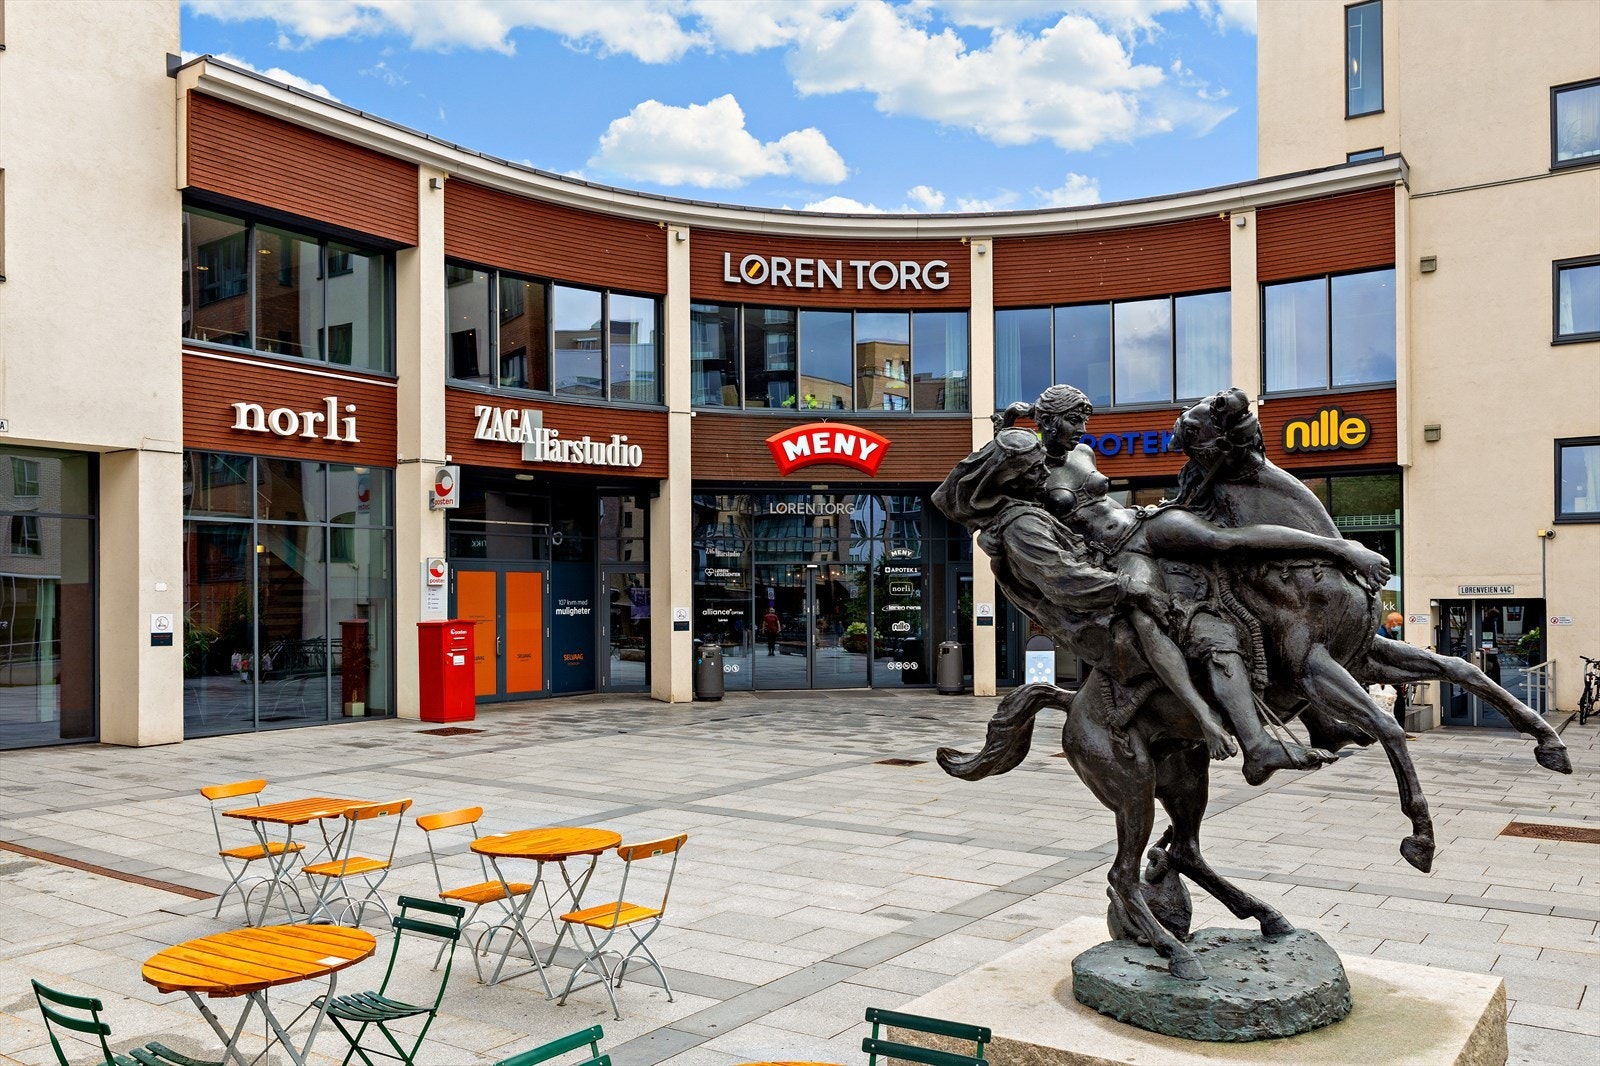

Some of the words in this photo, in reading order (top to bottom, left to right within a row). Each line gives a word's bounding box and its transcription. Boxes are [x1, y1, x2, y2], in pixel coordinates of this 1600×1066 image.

[849, 259, 950, 290] TORG
[230, 396, 360, 442] norli
[474, 405, 535, 443] ZAGA
[1286, 409, 1366, 449] nille
[533, 428, 643, 467] Hårstudio
[782, 432, 879, 462] MENY
[1079, 430, 1183, 456] POTEK
[816, 503, 856, 515] TORG
[890, 549, 913, 557] MENY
[1461, 586, 1498, 594] LØRENVEIEN
[555, 607, 591, 616] muligheter
